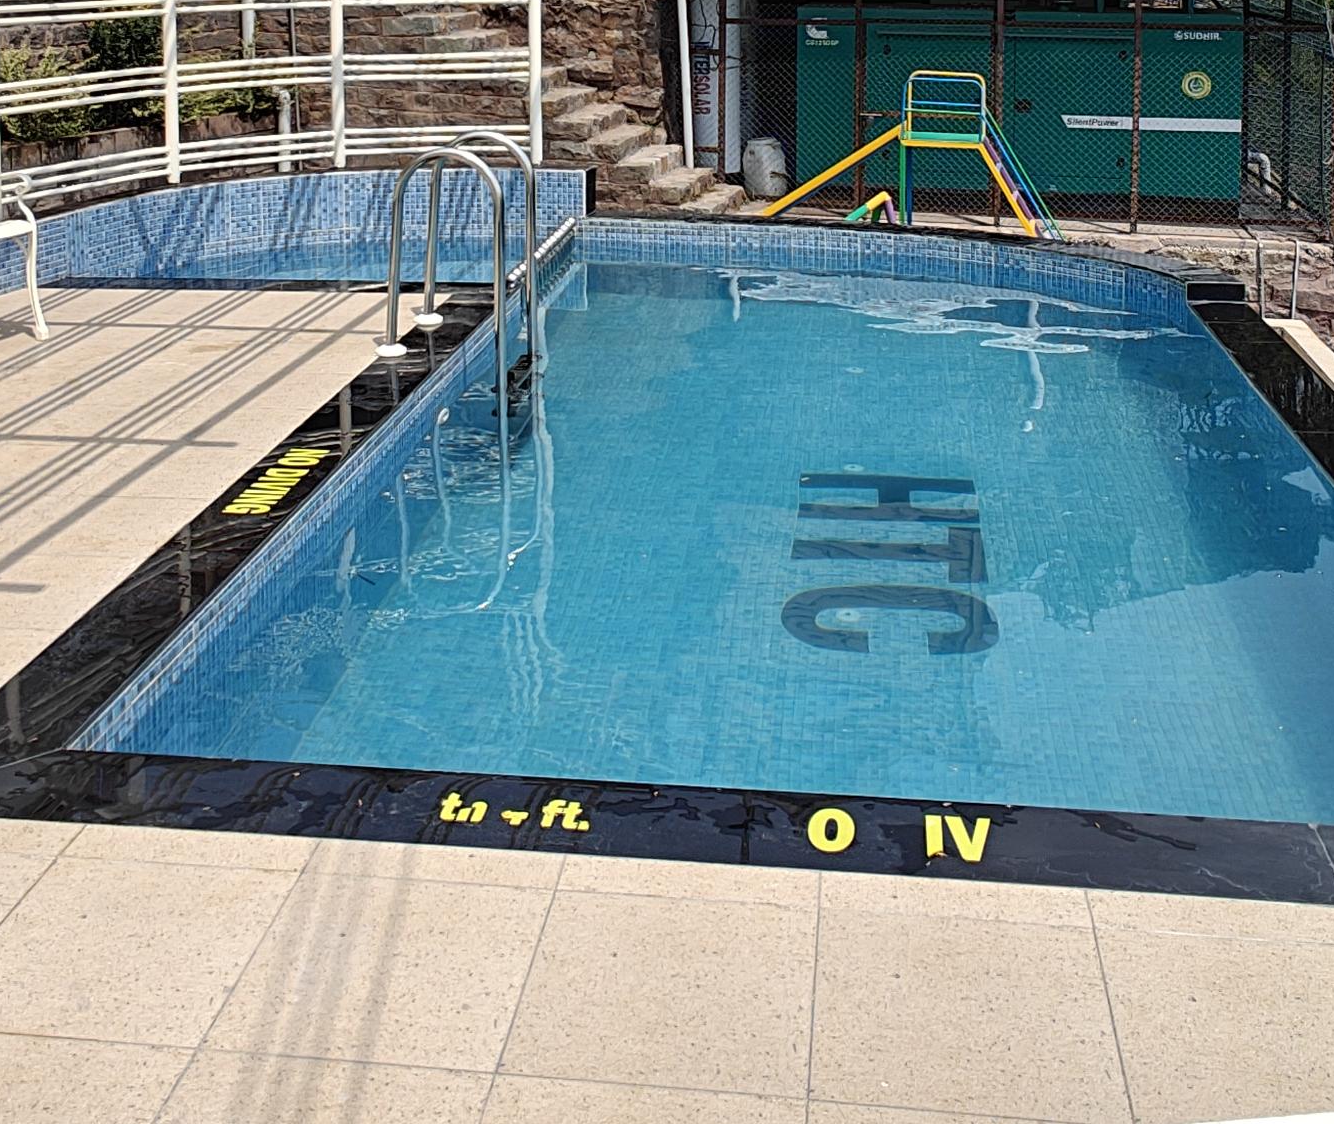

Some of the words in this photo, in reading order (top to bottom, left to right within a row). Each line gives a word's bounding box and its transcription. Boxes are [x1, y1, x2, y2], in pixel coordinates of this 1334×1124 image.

[277, 448, 331, 467] NO
[221, 468, 310, 515] DIVING
[780, 472, 1000, 655] HTC
